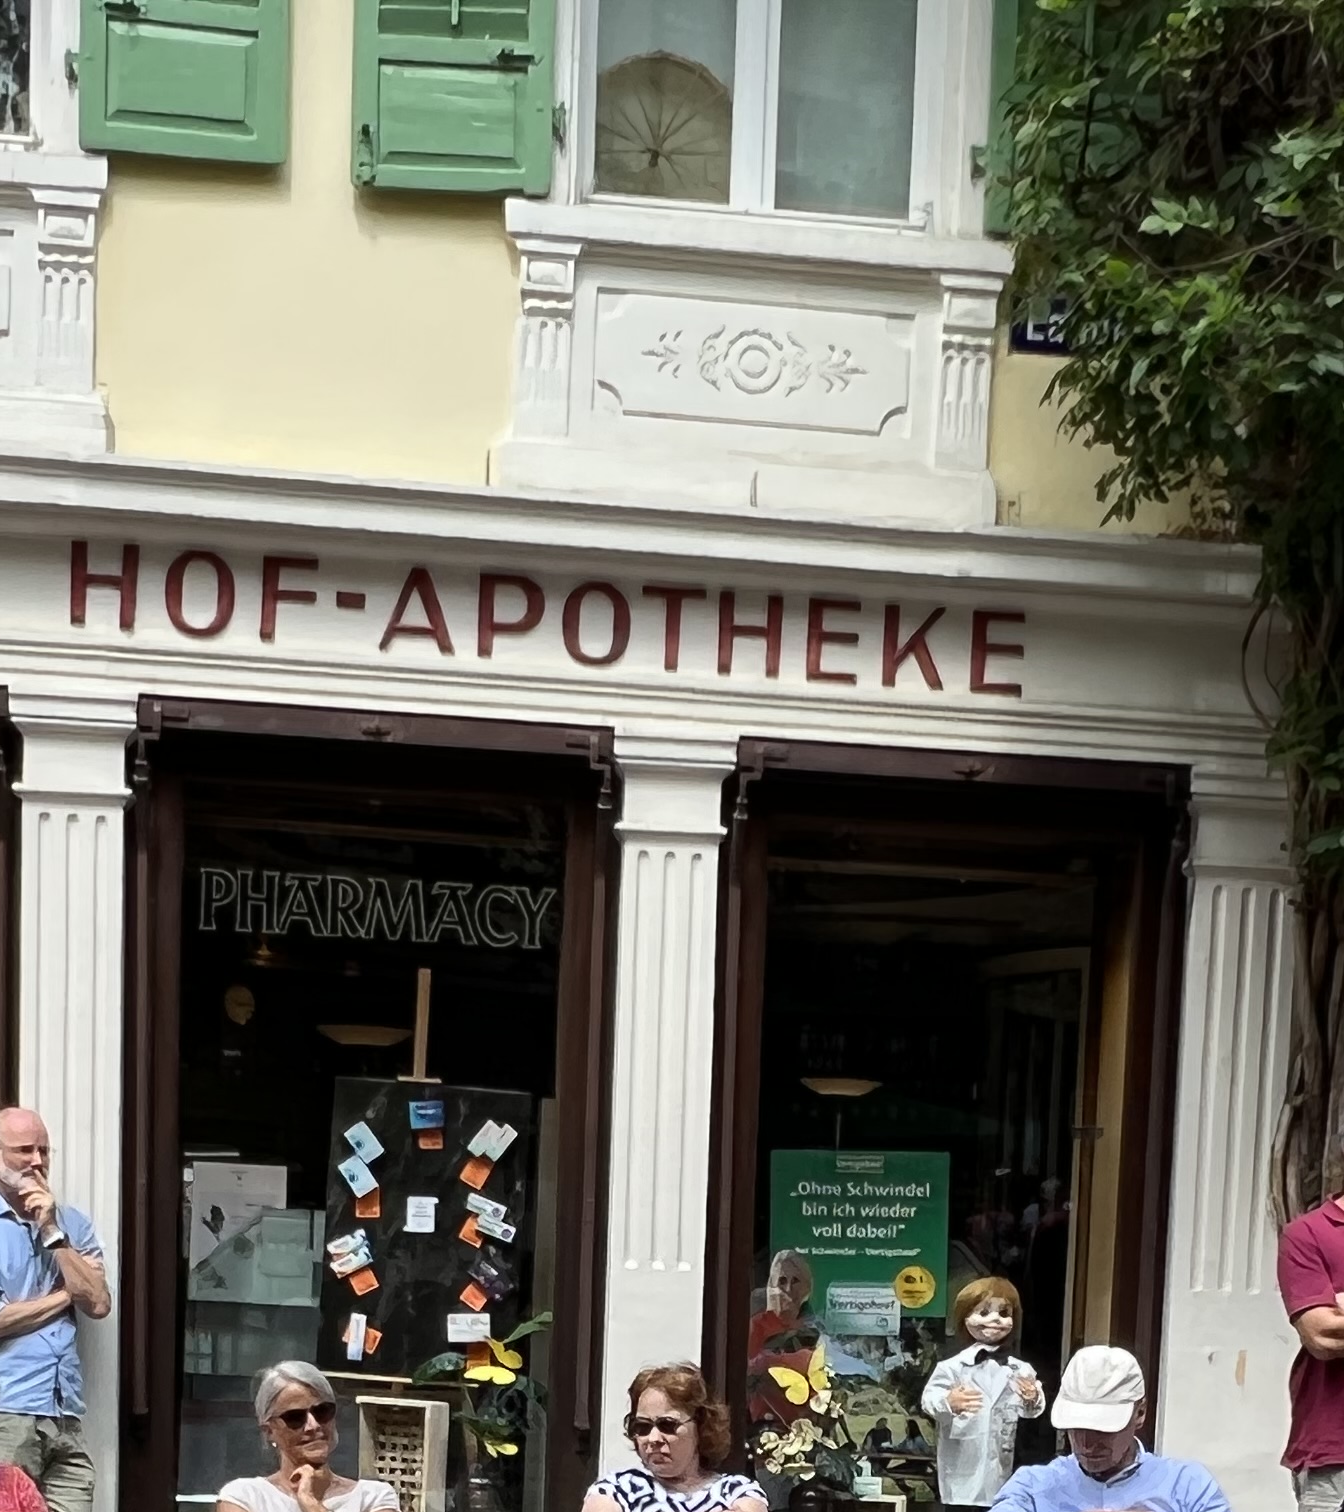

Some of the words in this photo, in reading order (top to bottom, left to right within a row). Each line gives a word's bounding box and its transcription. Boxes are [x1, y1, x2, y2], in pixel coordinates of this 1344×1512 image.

[70, 539, 1025, 698] HOF-APOTHEKE
[198, 867, 557, 949] PHARMACY
[847, 1181, 931, 1198] Schwindel
[802, 1201, 828, 1217] bin
[833, 1202, 856, 1217] ich
[860, 1202, 918, 1218] wieder
[812, 1222, 842, 1239] voll
